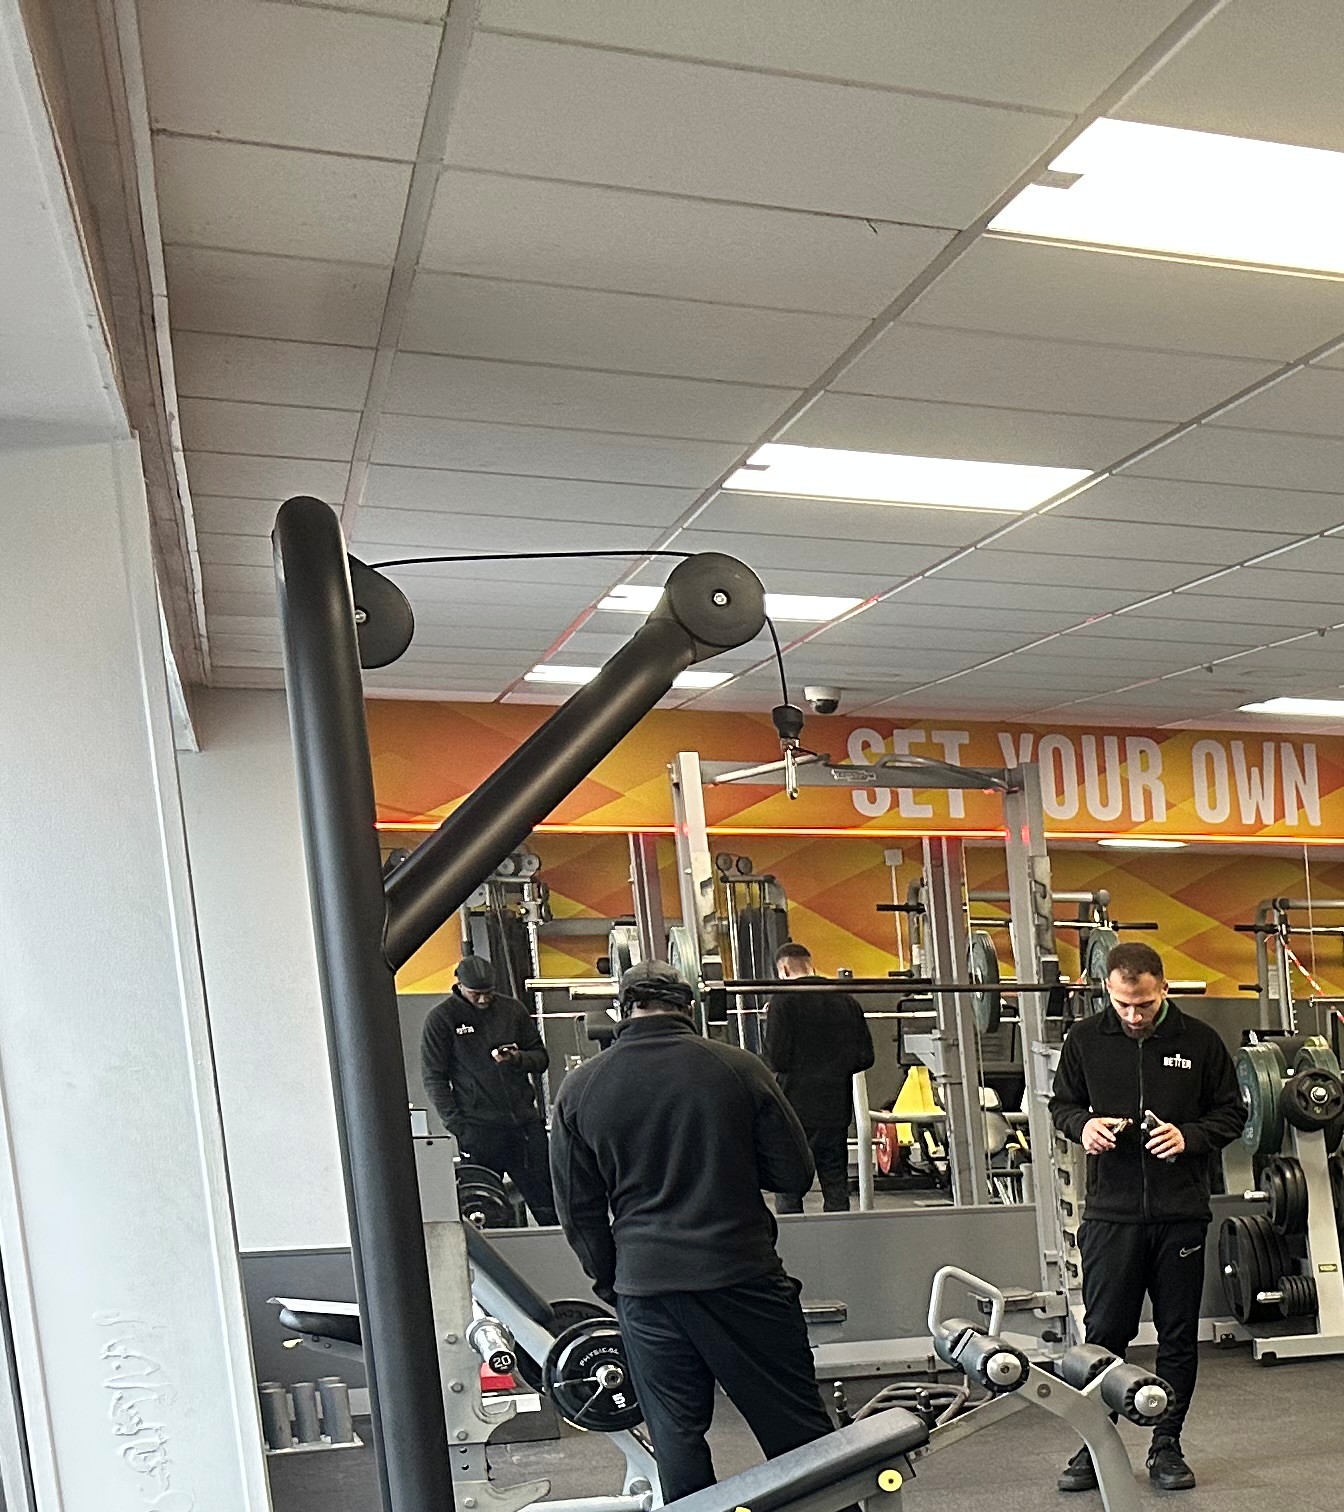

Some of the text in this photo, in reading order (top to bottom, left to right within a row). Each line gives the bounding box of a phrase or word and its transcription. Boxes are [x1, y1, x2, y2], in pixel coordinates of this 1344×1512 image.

[847, 728, 970, 819] SET
[1191, 739, 1322, 827] OWN
[493, 1354, 512, 1368] 20
[579, 1347, 620, 1367] PHYSICAL
